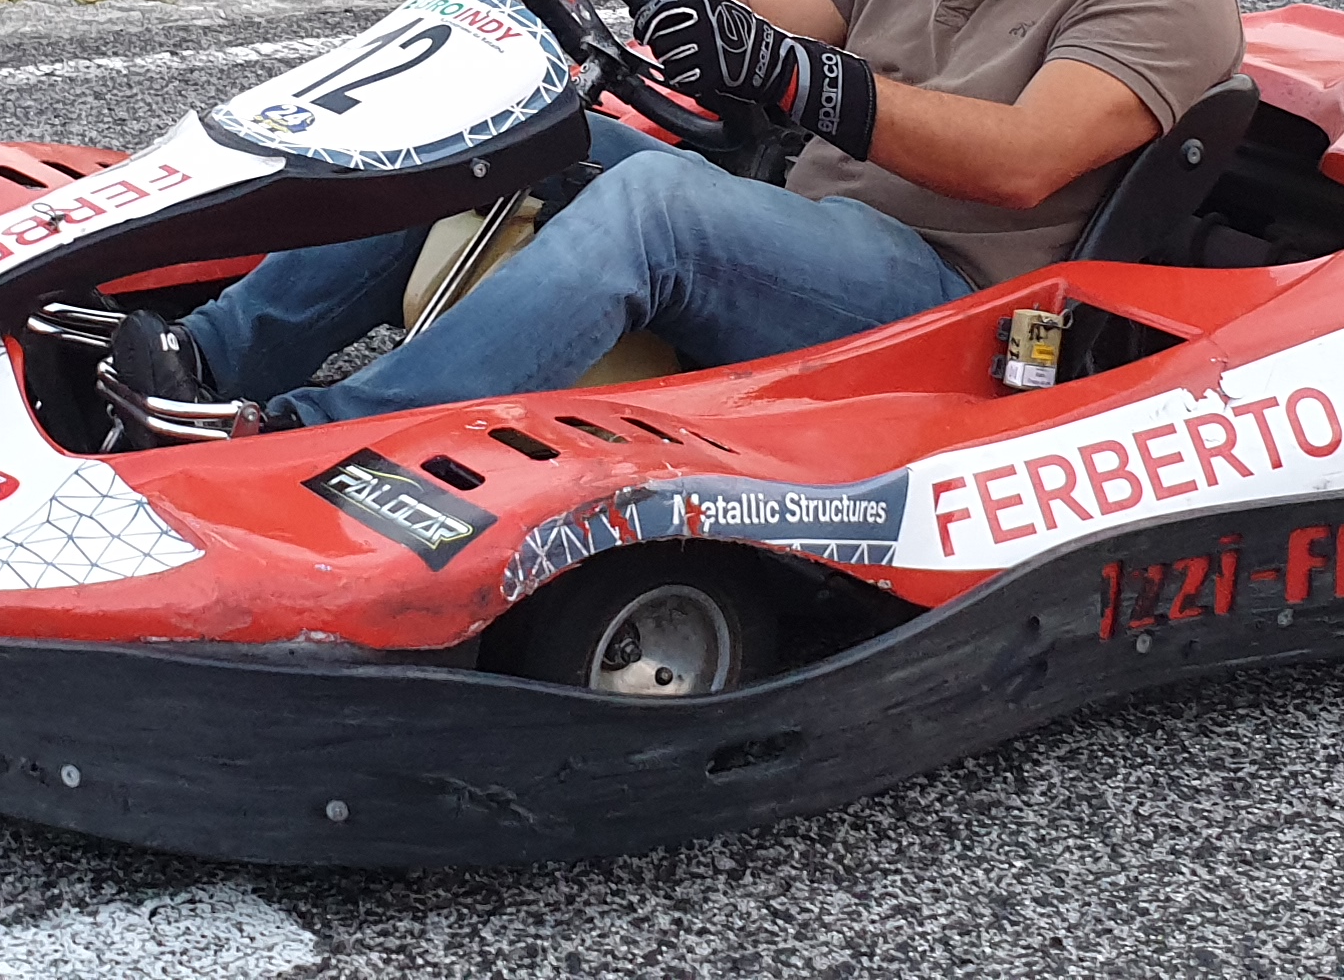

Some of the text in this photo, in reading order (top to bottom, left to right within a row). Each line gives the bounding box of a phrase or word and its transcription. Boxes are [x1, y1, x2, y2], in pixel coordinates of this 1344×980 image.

[291, 16, 453, 116] 12
[817, 53, 842, 135] sparco
[327, 465, 470, 543] PALOCAR
[672, 491, 887, 525] Metallic Structures
[931, 386, 1343, 558] FERBERTO
